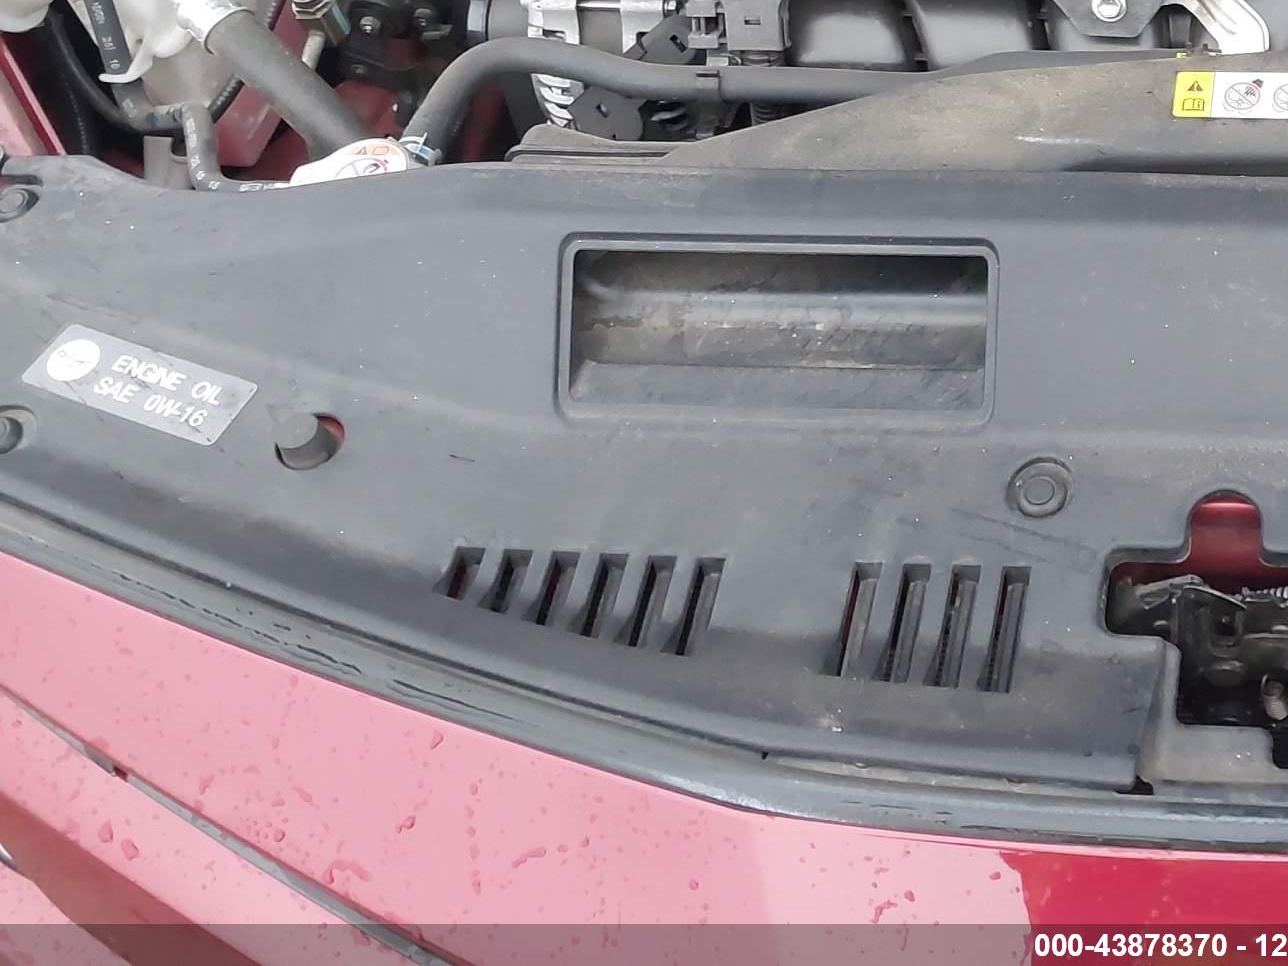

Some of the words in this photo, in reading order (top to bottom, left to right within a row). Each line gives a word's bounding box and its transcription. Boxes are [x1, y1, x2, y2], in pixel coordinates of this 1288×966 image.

[92, 376, 140, 404] SAE
[143, 393, 208, 428] 0W-16
[110, 353, 187, 392] ENGINE
[190, 381, 226, 406] OIL
